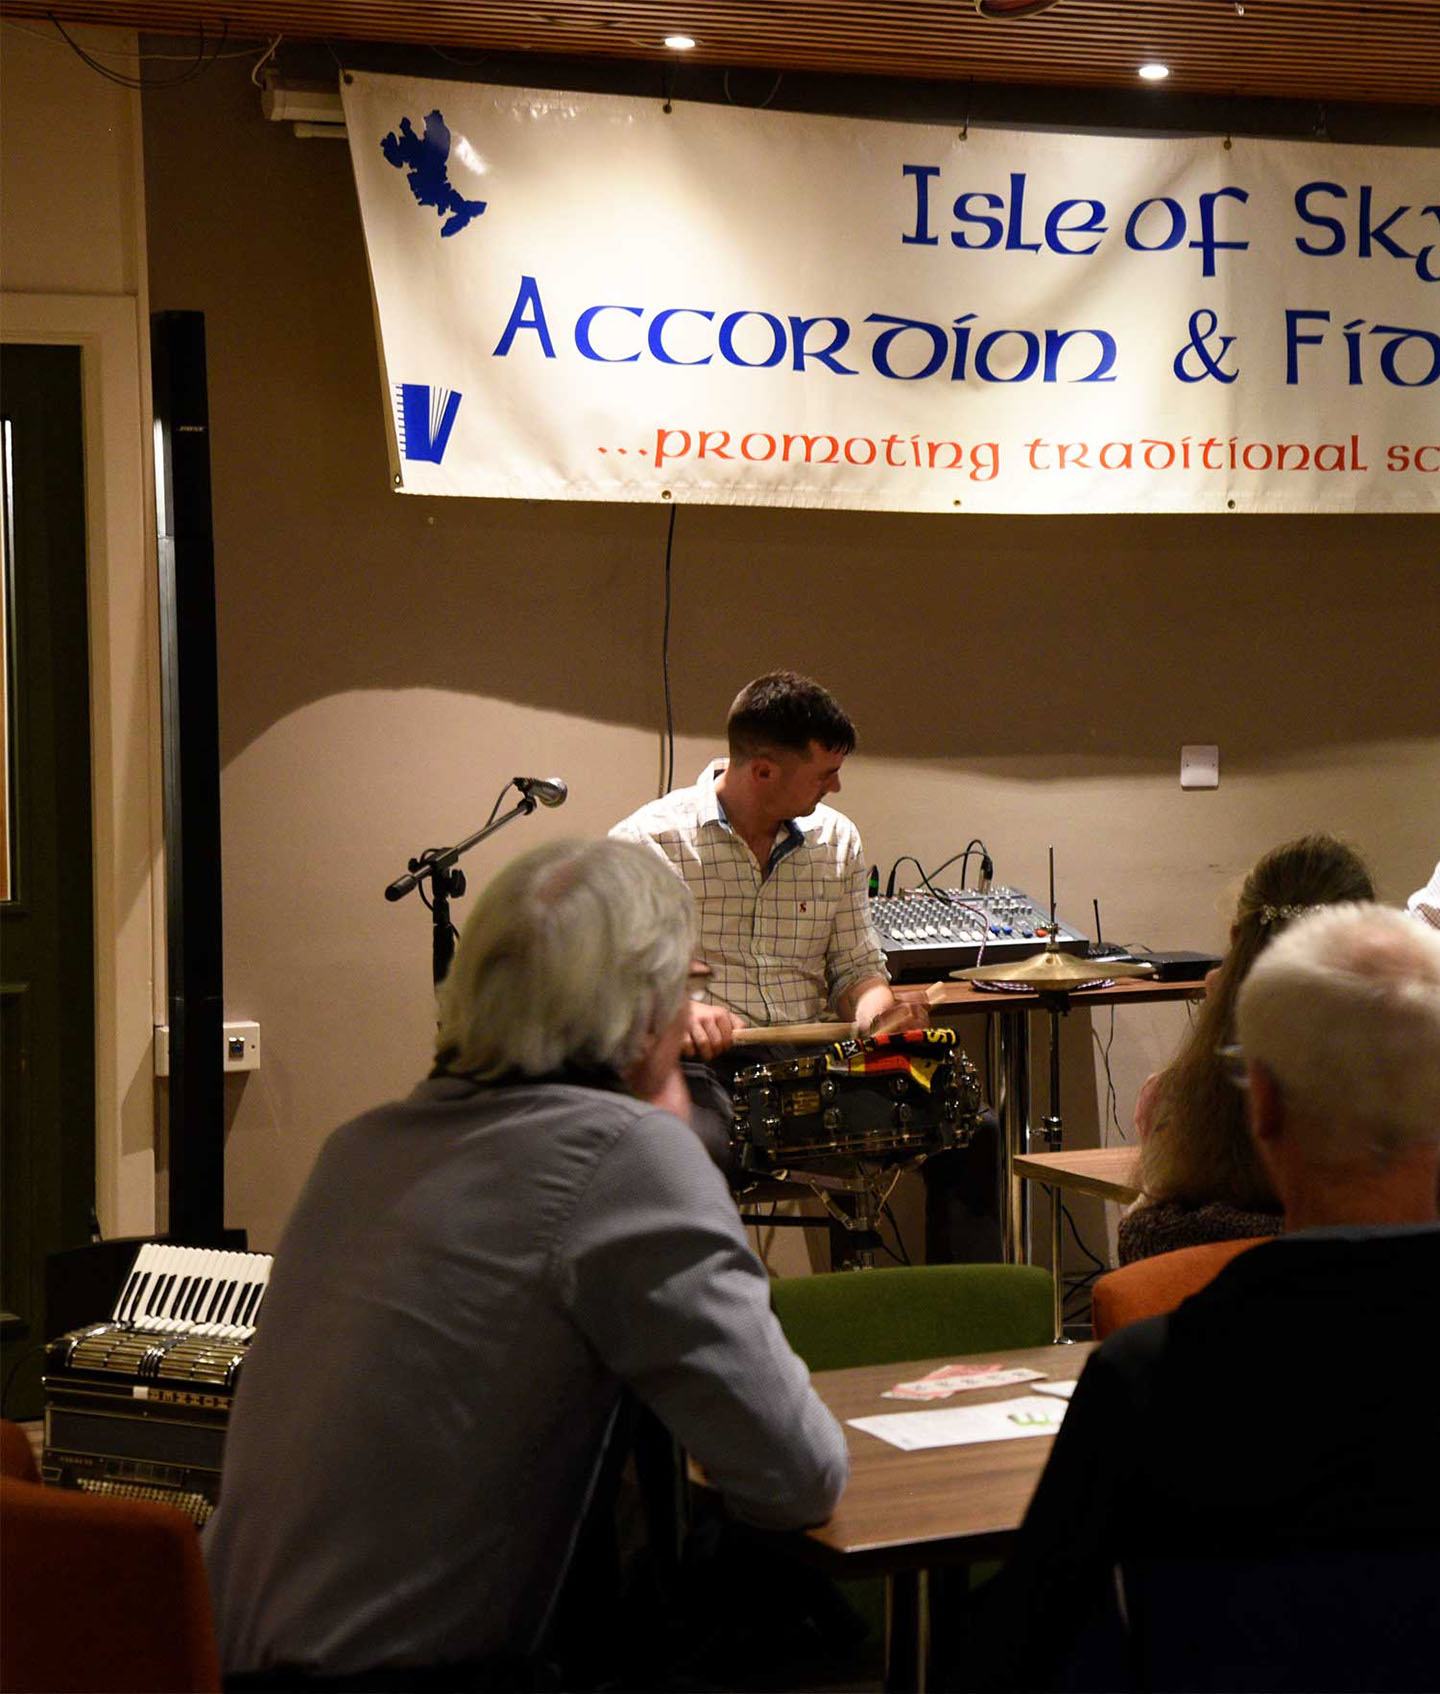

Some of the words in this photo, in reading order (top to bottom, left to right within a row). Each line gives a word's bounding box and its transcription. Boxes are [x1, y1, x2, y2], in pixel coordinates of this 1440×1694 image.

[900, 164, 1109, 256] Isle
[1126, 185, 1250, 278] of
[491, 275, 1118, 383] Accordion
[1173, 308, 1240, 386] &
[1024, 434, 1369, 474] traditional
